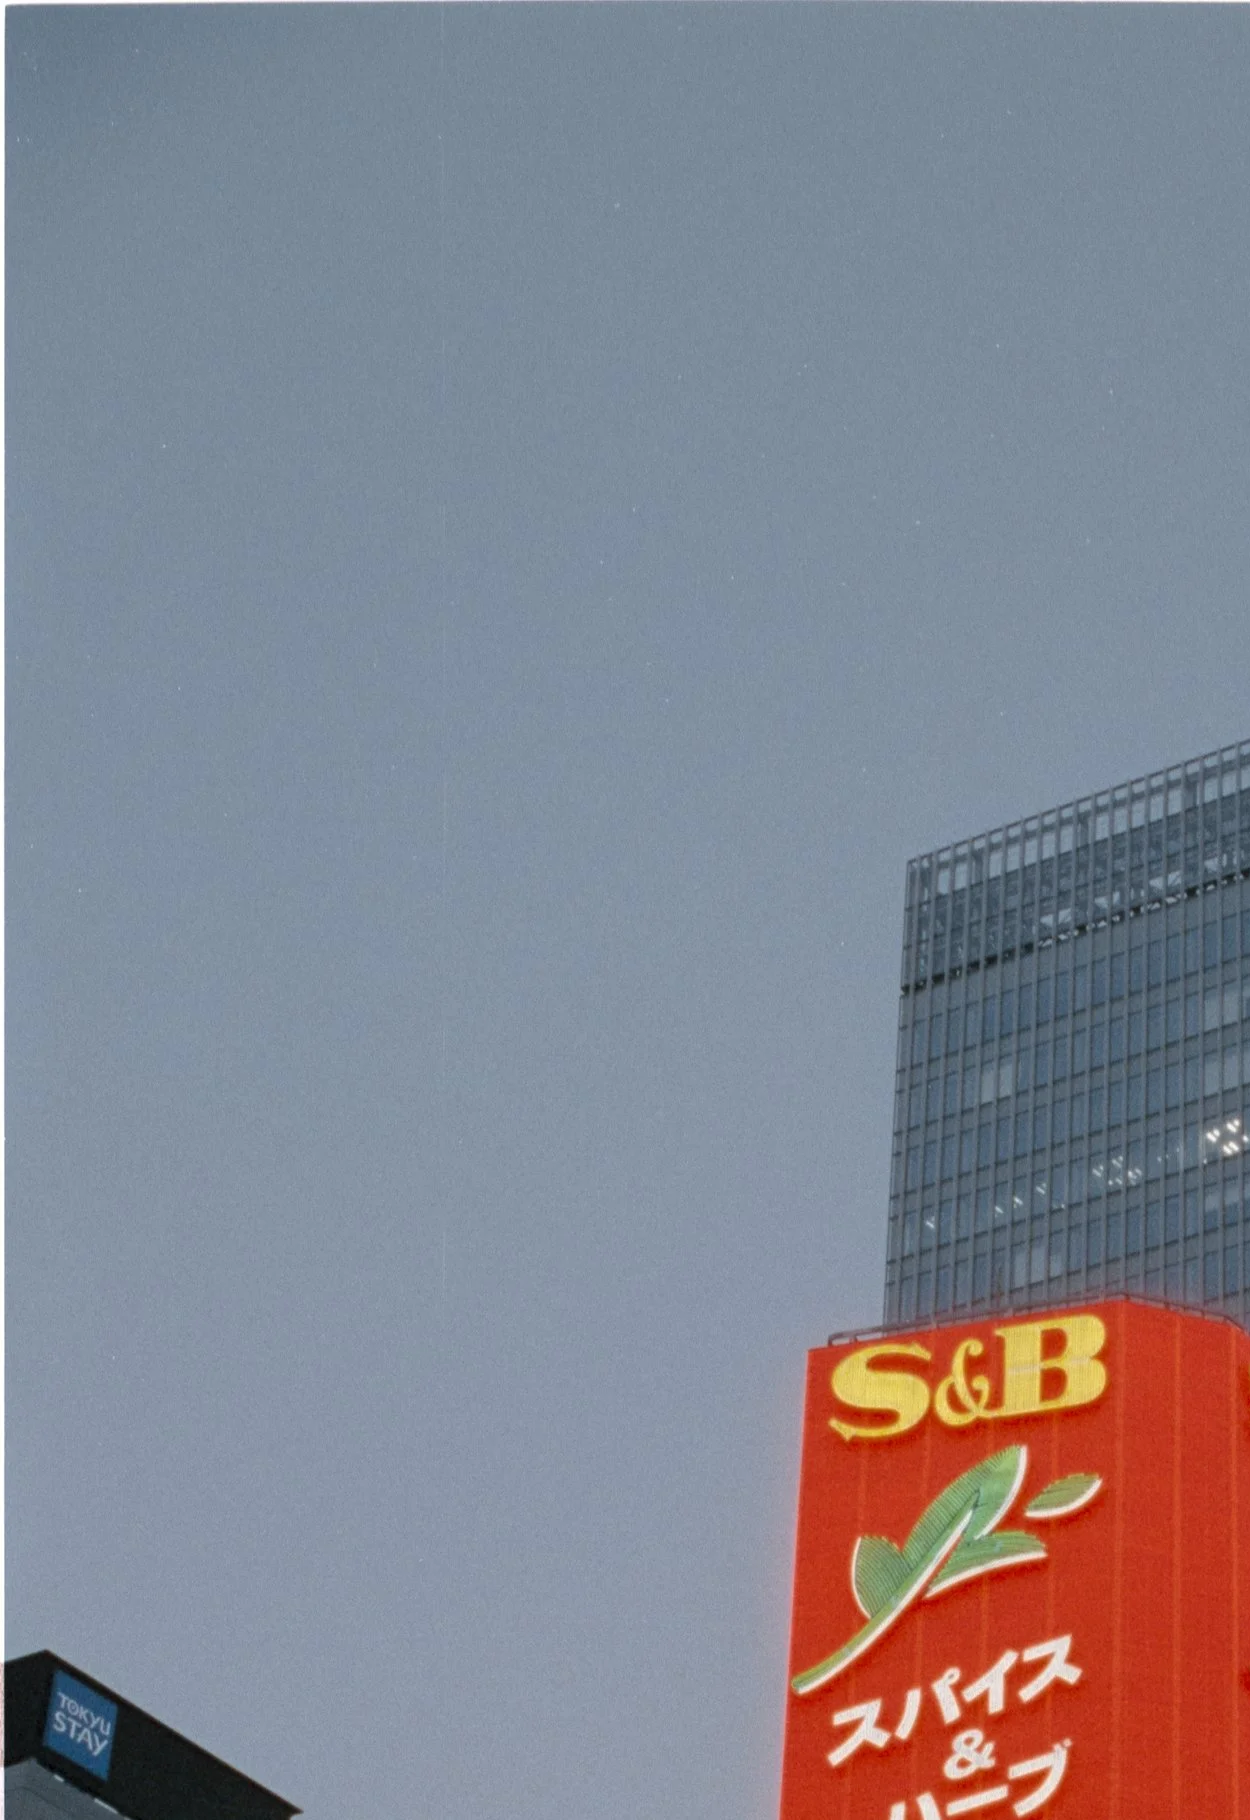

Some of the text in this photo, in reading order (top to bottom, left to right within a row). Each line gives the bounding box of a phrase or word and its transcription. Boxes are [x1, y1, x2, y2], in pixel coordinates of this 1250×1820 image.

[830, 1312, 1107, 1439] S&B
[57, 1691, 111, 1736] TOKYU
[826, 1634, 1082, 1765] スパイス
[53, 1711, 108, 1757] STAY
[943, 1729, 996, 1780] &
